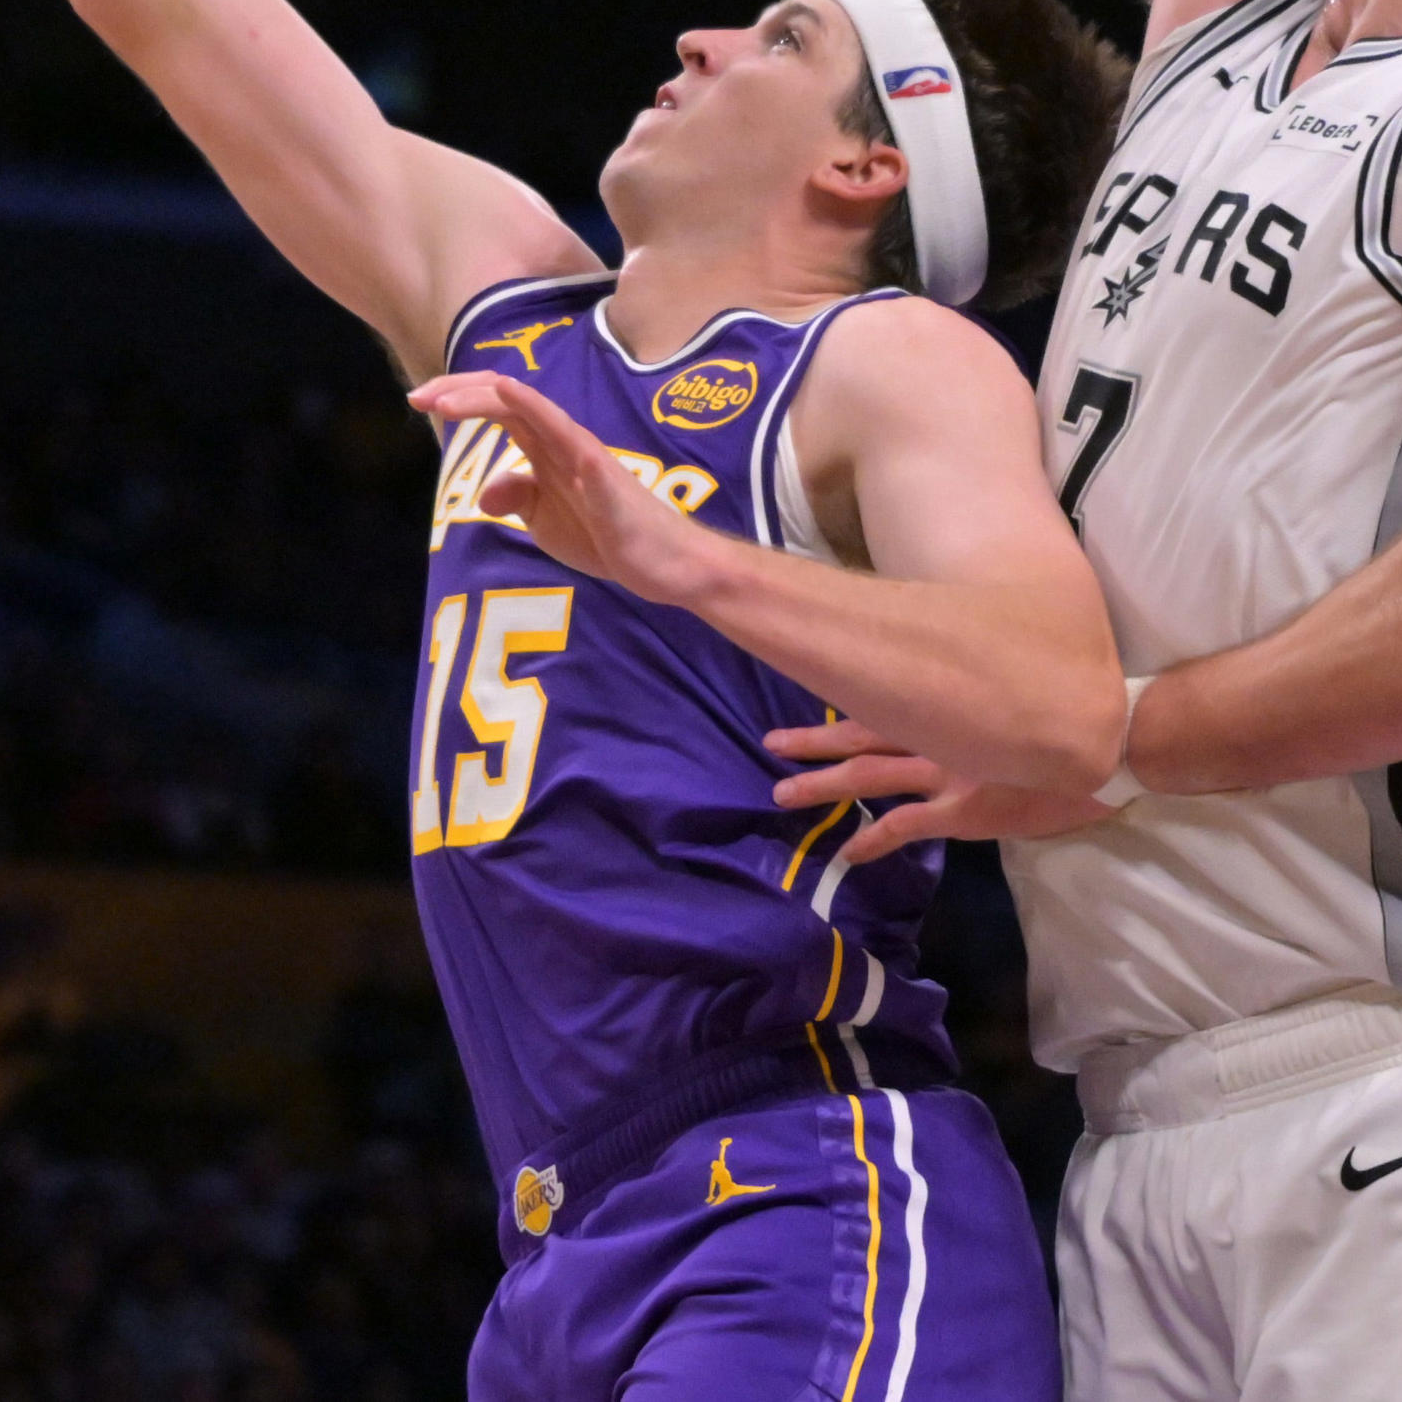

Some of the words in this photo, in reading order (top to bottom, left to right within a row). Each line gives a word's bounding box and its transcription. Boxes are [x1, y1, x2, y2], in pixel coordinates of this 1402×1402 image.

[1288, 115, 1358, 139] LEDGER
[667, 375, 749, 411] bibigo
[1057, 360, 1142, 546] 7
[412, 586, 574, 856] 15
